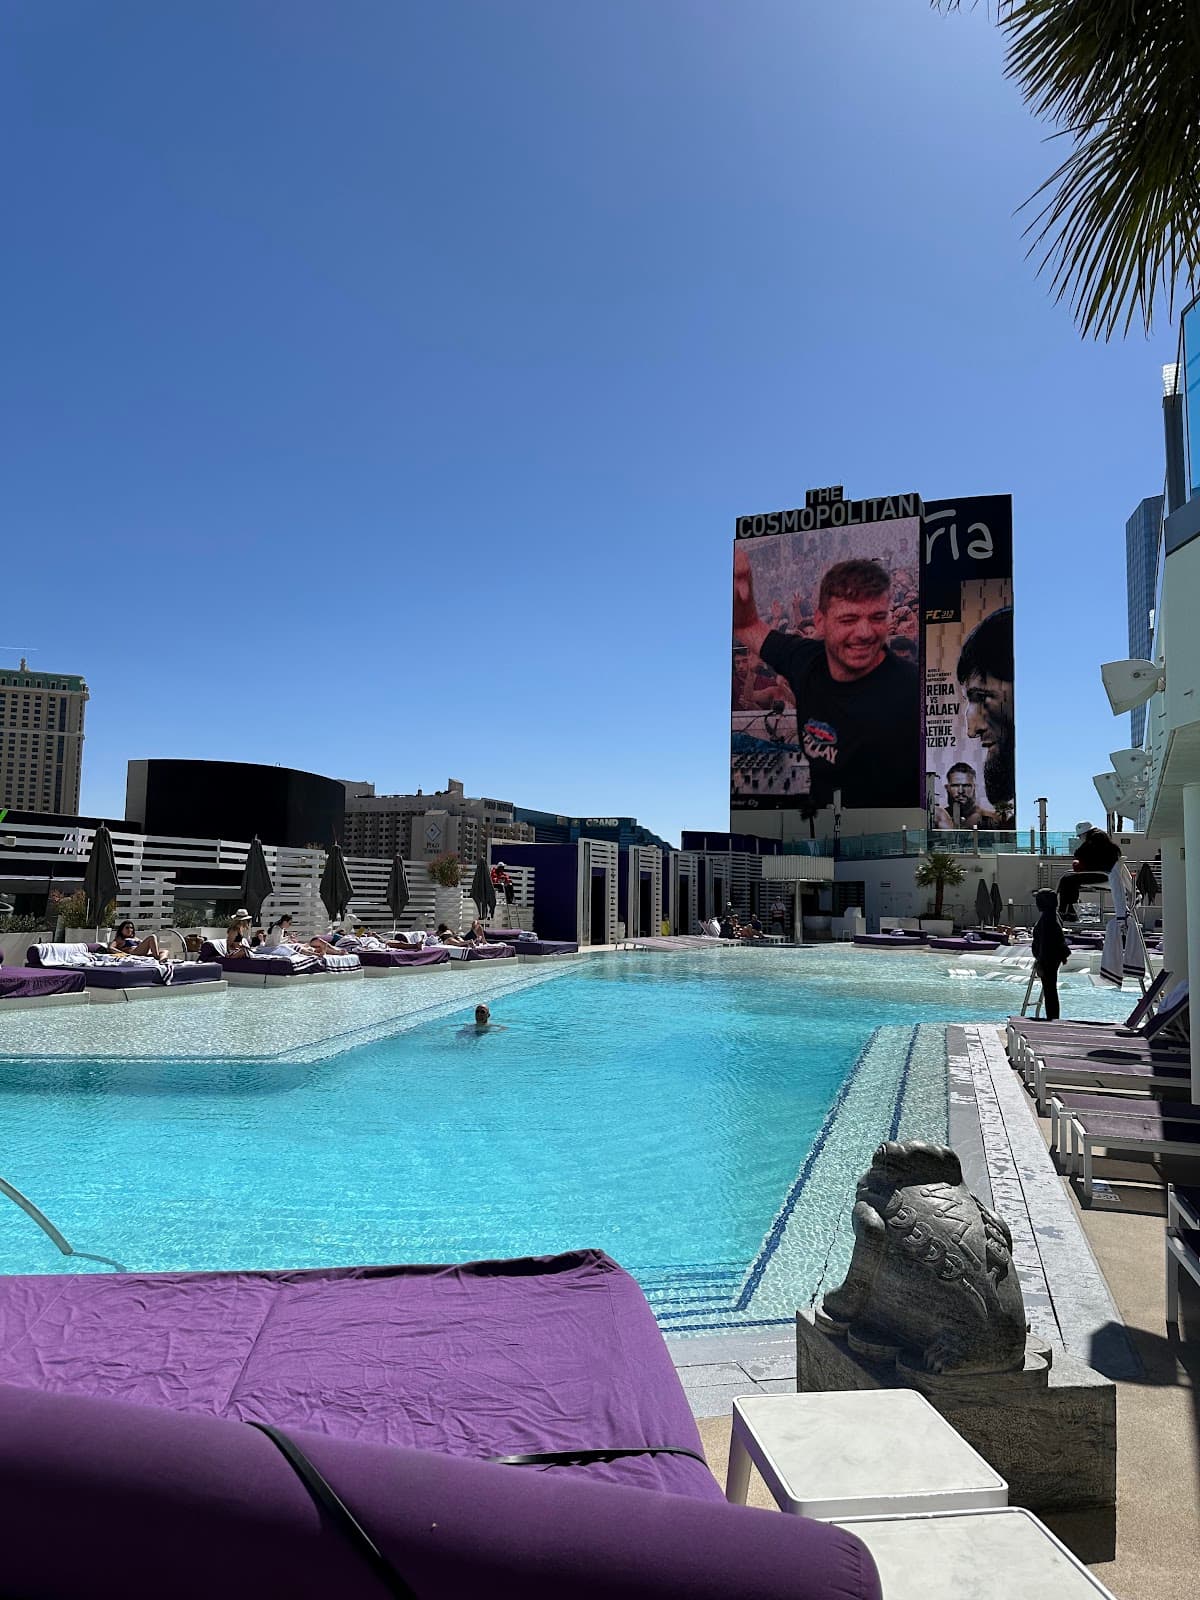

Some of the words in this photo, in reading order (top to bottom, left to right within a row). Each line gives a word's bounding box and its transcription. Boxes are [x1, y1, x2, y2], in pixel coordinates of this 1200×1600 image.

[807, 486, 841, 504] THE
[738, 493, 914, 538] COSMOPOLITAN
[926, 737, 949, 748] IZIEV
[585, 818, 619, 828] GRAND
